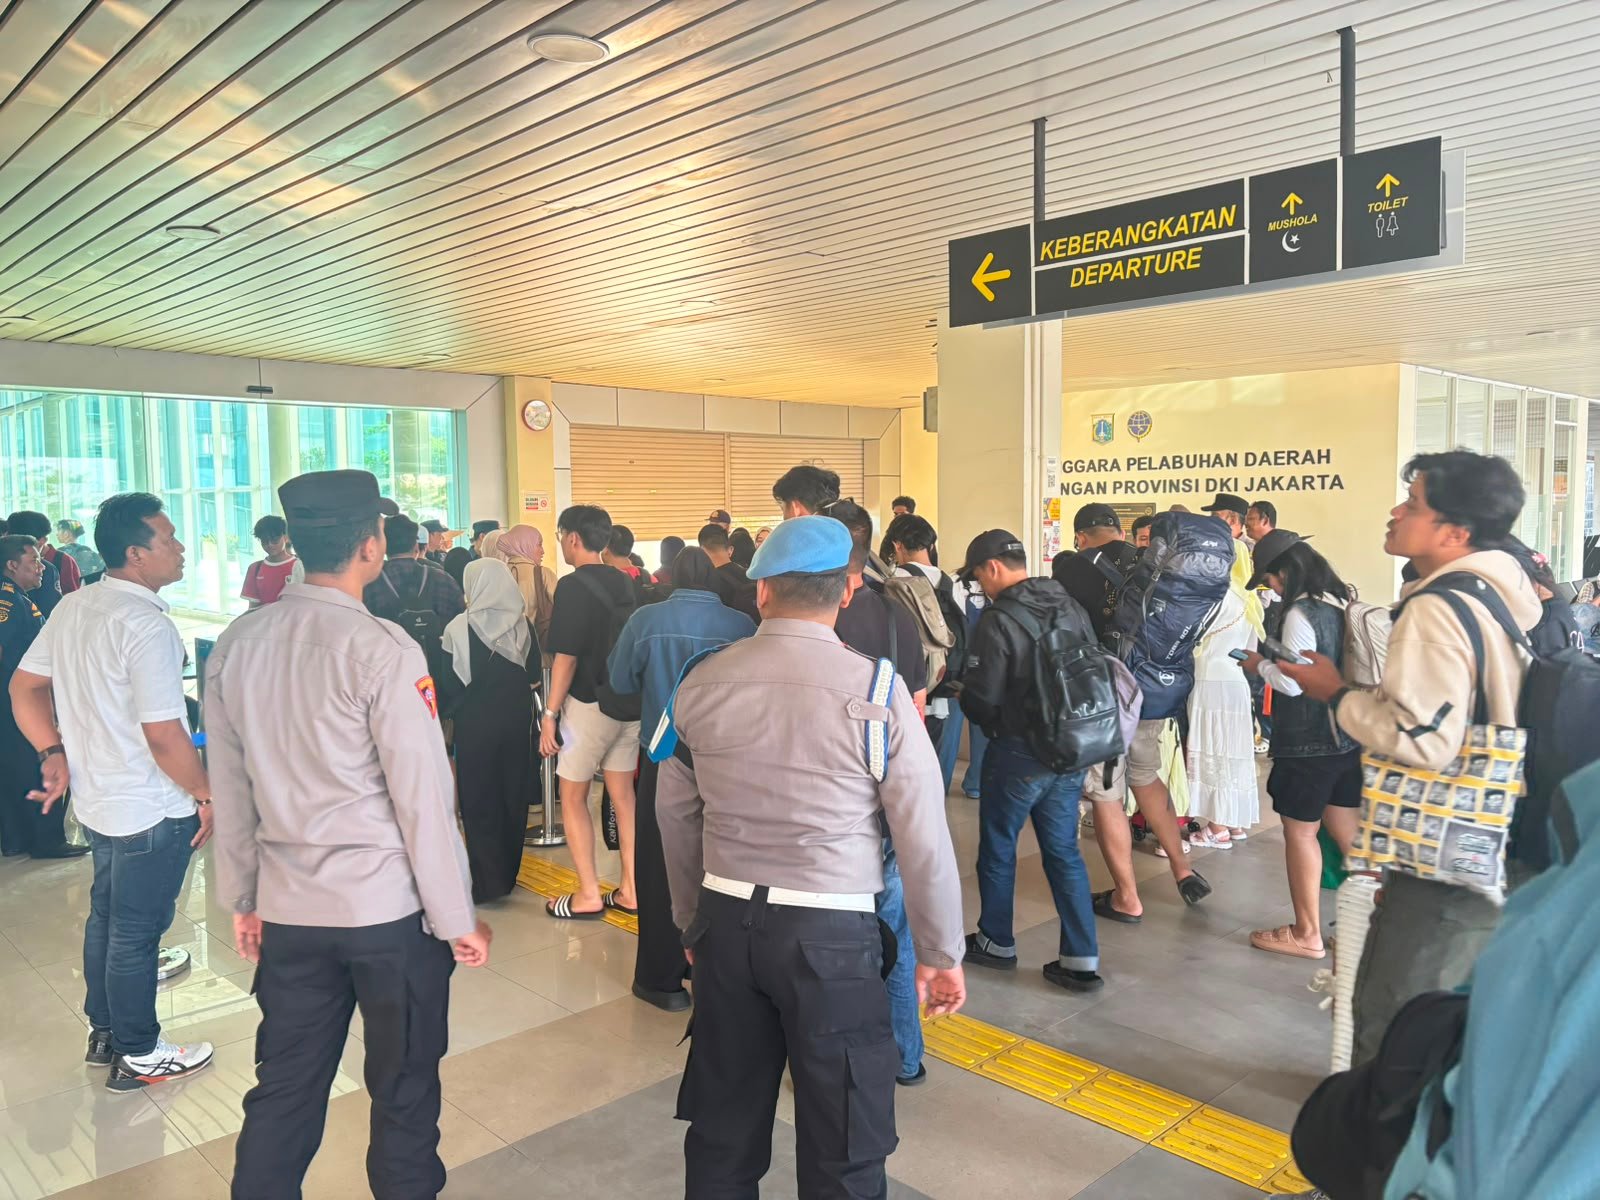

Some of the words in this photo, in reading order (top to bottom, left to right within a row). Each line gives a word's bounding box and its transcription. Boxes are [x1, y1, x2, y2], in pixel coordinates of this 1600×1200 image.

[1367, 195, 1409, 214] TOILET
[1040, 205, 1237, 261] KEBERANGKATAN
[1267, 213, 1318, 232] MUSHOLA
[1069, 246, 1202, 289] DEPARTURE
[1062, 458, 1121, 474] GGARA
[1126, 453, 1238, 472] PELABUHAN
[1245, 448, 1331, 468] DAERAH
[1061, 481, 1107, 496] NGAN
[1112, 477, 1199, 495] PROVINSI
[1205, 476, 1239, 493] DKI
[1244, 474, 1344, 492] JAKARTA
